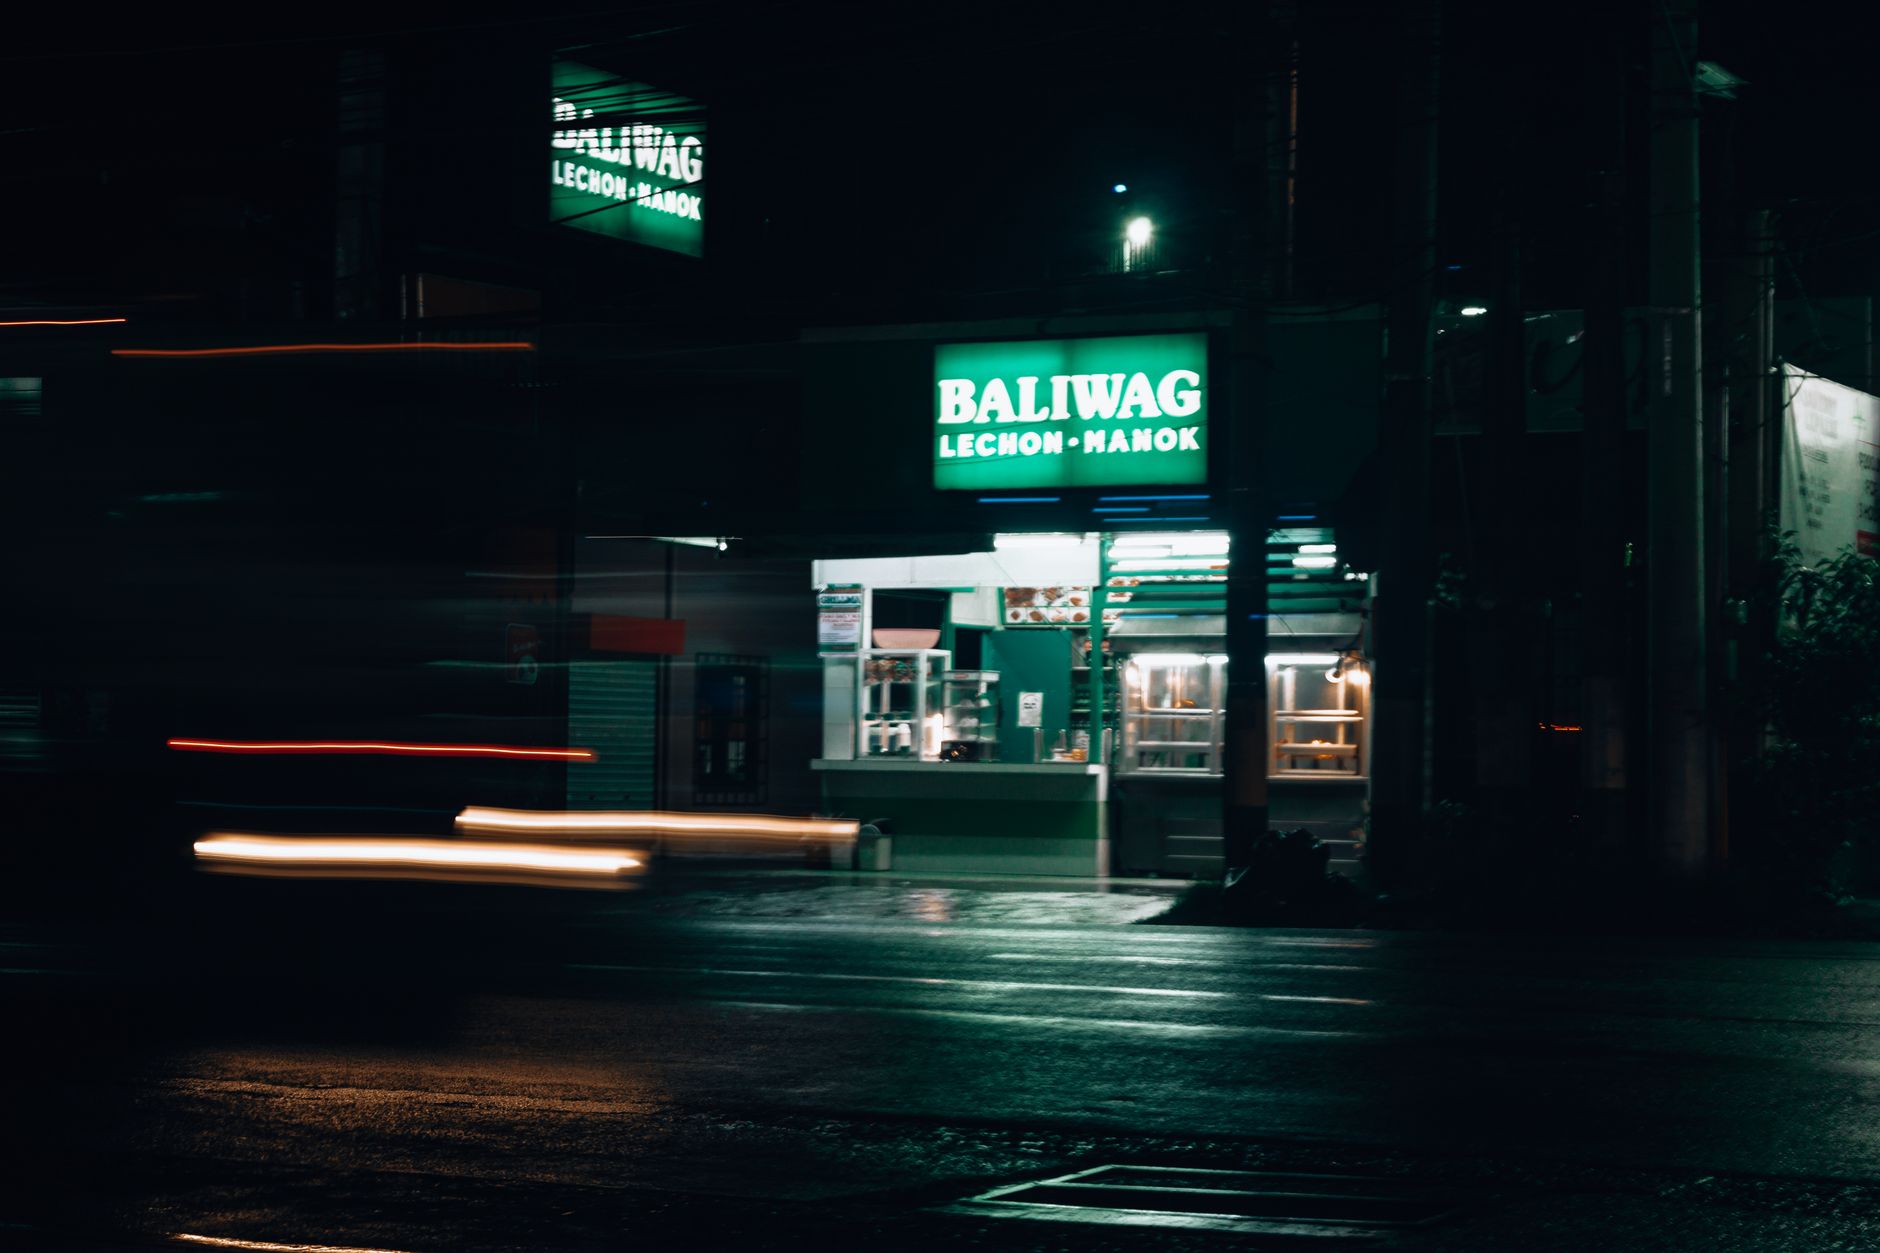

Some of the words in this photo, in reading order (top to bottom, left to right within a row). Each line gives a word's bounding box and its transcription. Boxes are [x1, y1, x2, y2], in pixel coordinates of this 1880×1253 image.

[552, 97, 702, 183] BALIWAG
[553, 160, 627, 201] LECHON
[637, 182, 702, 220] MANOK
[938, 369, 1201, 424] BALIWAG
[939, 431, 1063, 458] LECHON
[1083, 426, 1200, 454] MANOK
